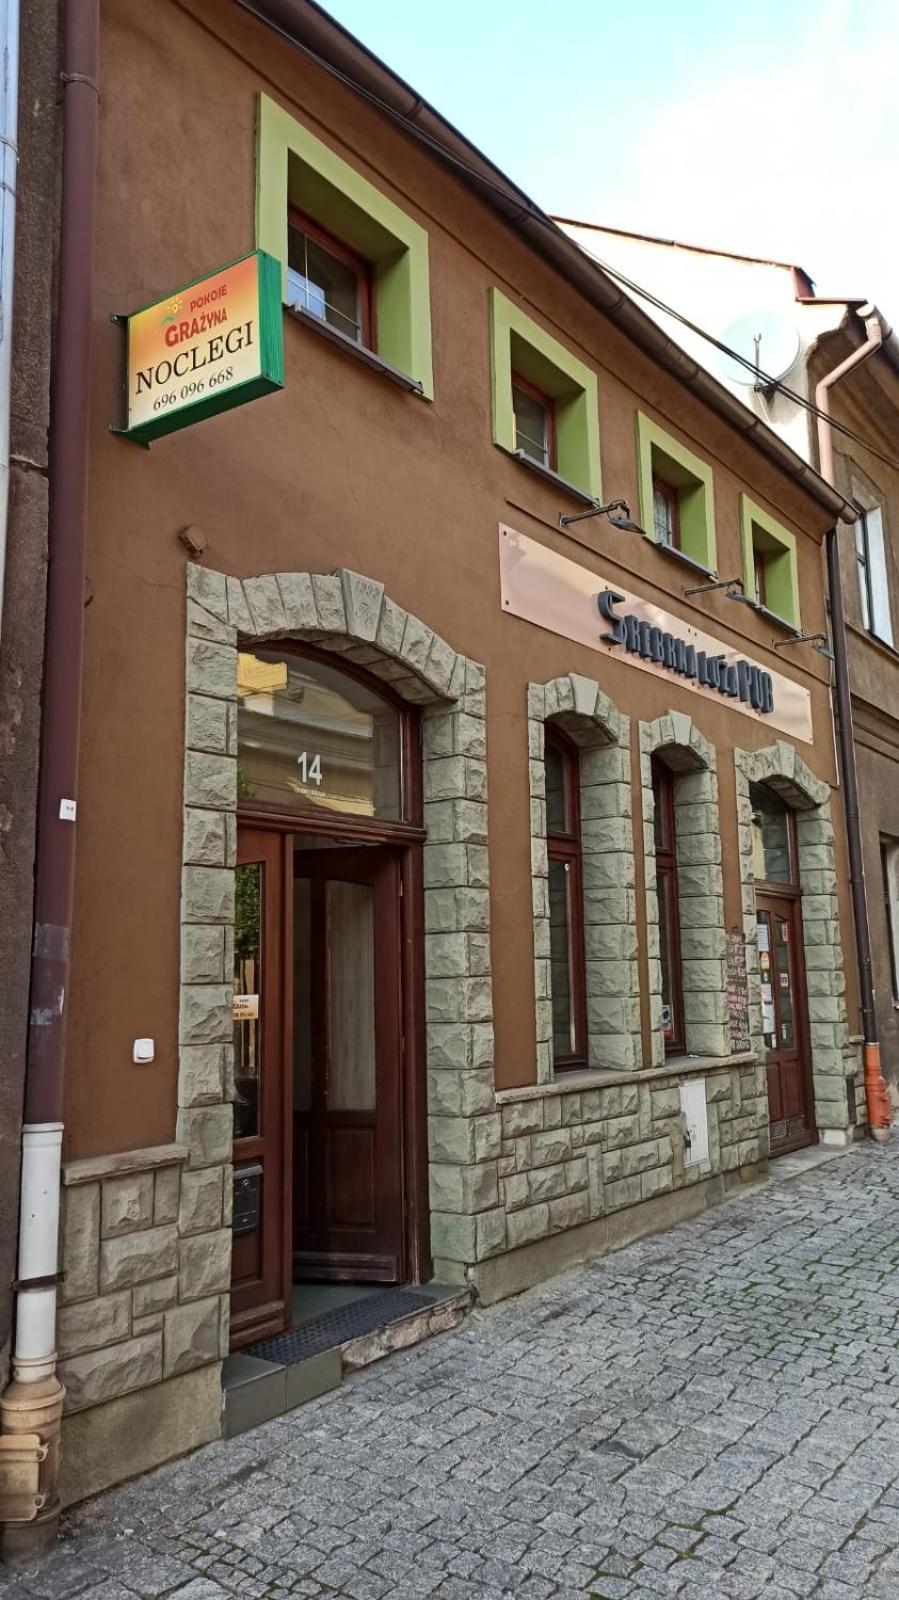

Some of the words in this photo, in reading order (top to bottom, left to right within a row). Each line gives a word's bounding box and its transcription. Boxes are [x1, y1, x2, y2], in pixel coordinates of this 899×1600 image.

[190, 285, 228, 312] POKOJE
[164, 307, 228, 347] GRAŻYNA
[135, 321, 253, 395] NOCLEGI
[153, 390, 177, 411] 696
[180, 380, 205, 400] 096
[209, 366, 234, 388] 668
[736, 660, 774, 714] PUB
[297, 751, 323, 786] 14
